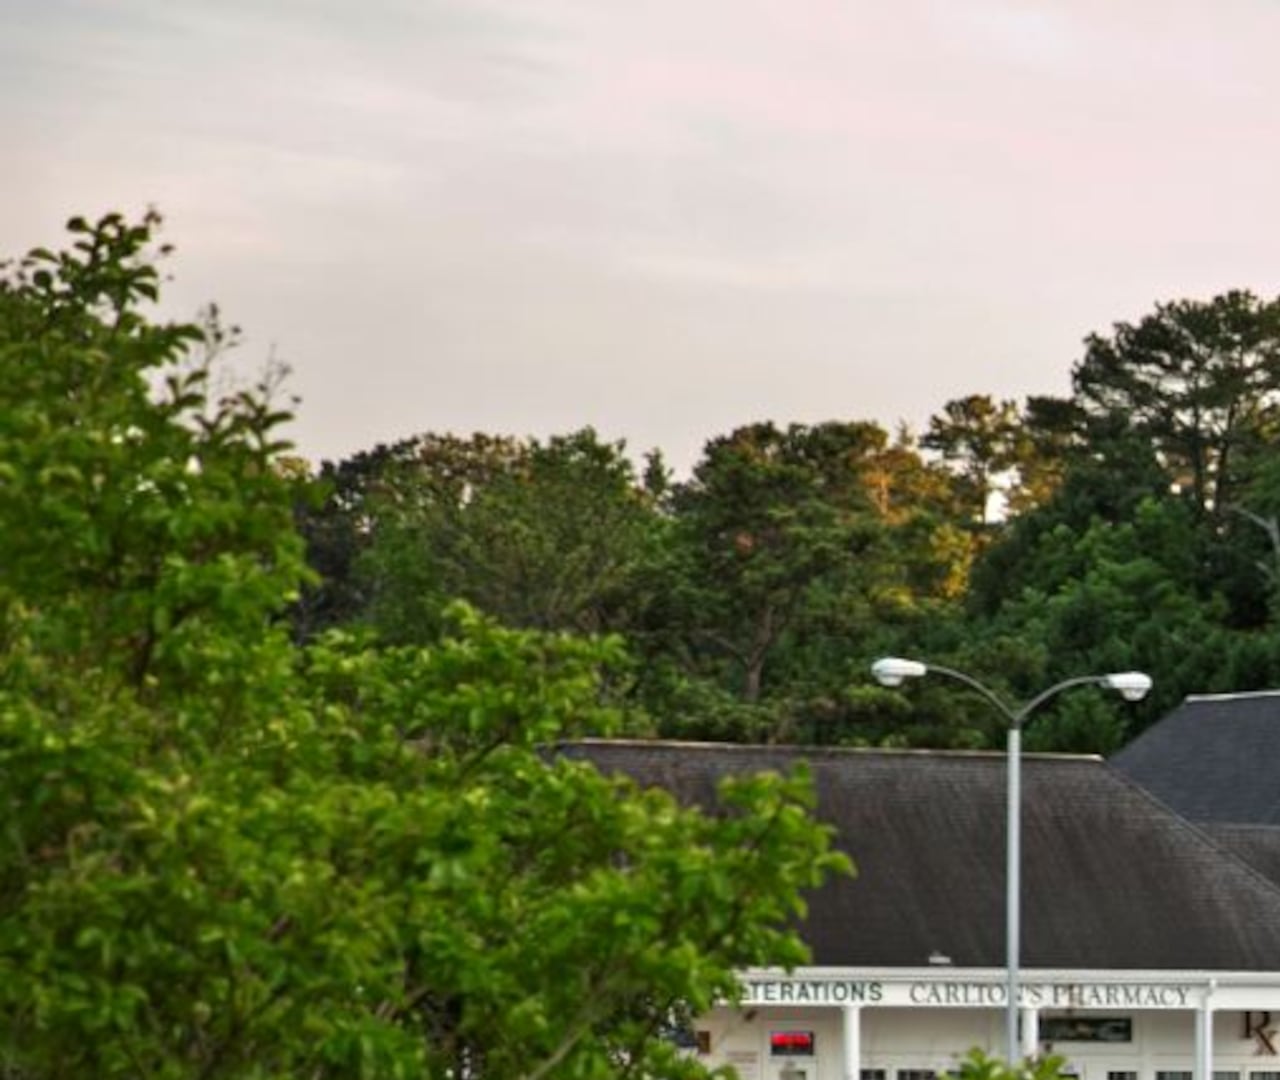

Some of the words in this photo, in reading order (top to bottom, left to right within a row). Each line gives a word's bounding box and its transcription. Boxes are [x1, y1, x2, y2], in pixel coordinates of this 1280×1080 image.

[741, 981, 883, 1001] TERATIONS
[910, 981, 1042, 1004] CARLTO'S
[1053, 983, 1191, 1005] PHARMACY
